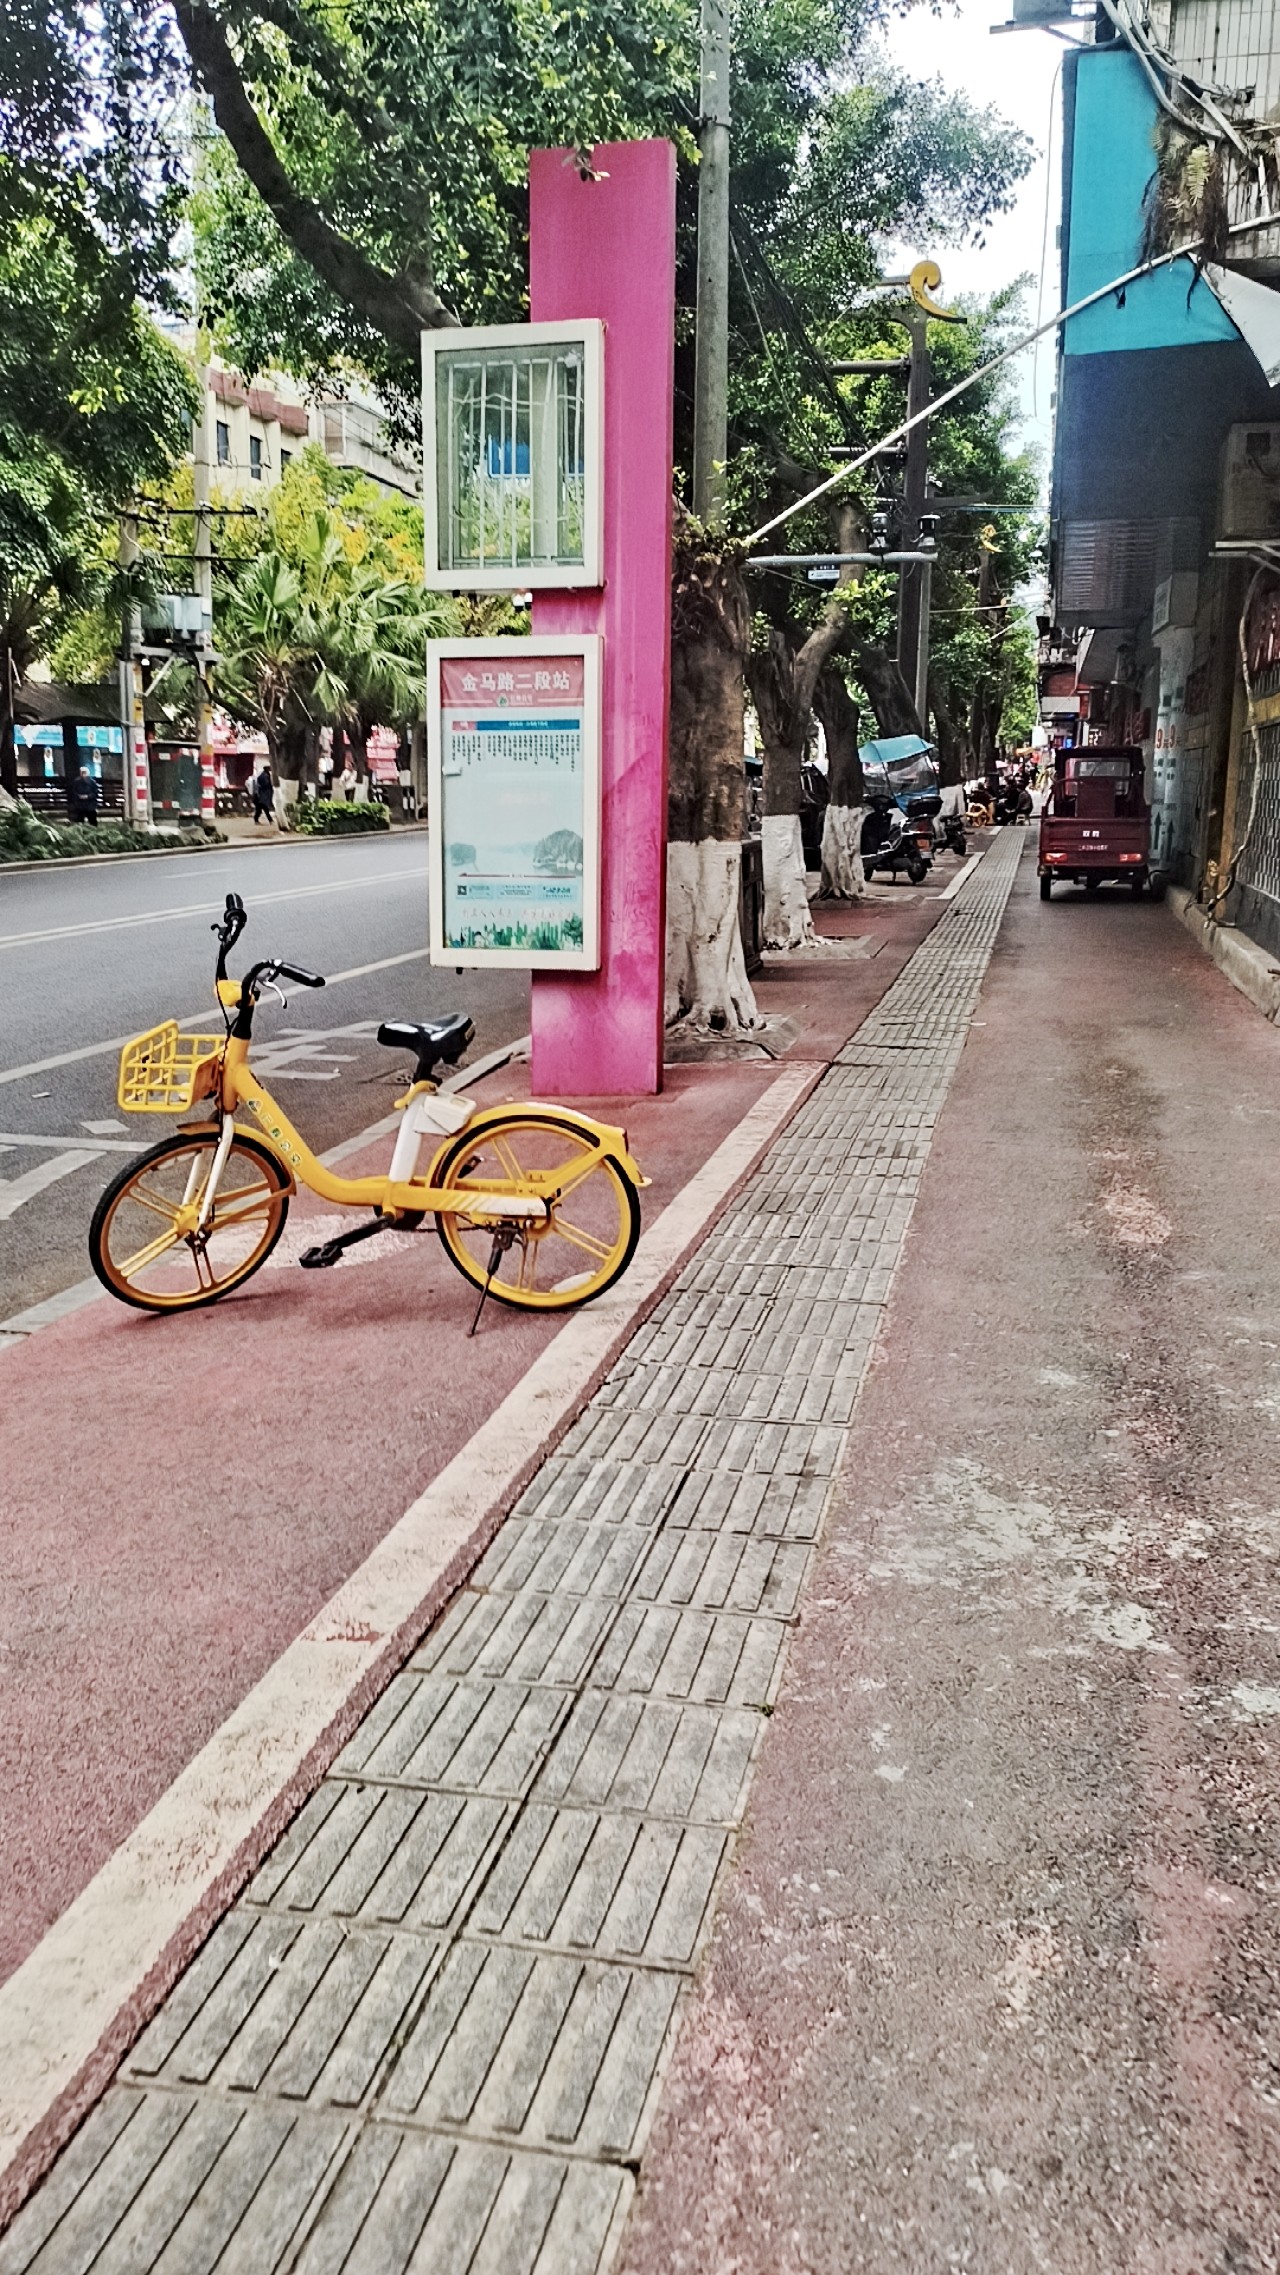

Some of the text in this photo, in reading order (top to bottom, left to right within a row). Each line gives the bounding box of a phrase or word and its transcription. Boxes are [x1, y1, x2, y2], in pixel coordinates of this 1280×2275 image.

[461, 671, 570, 691] 金马路二段站
